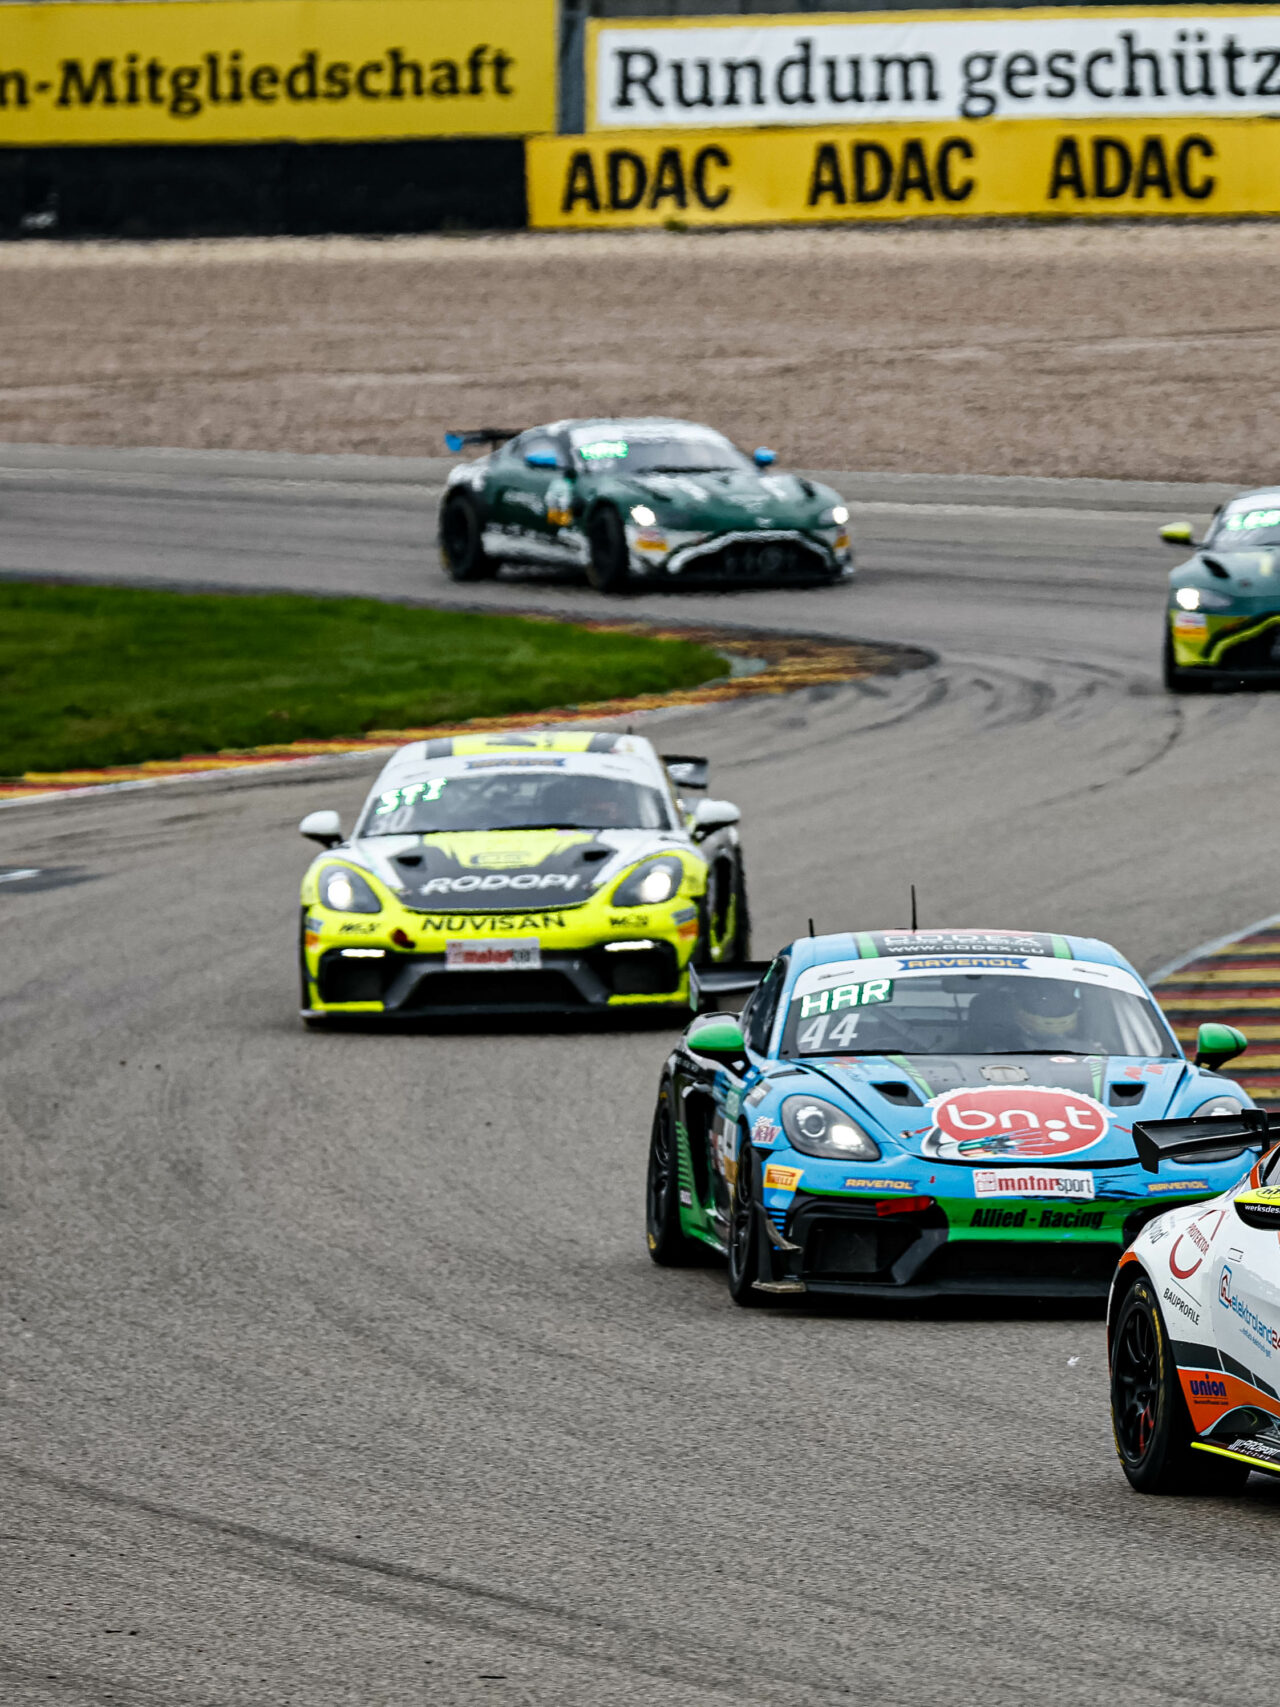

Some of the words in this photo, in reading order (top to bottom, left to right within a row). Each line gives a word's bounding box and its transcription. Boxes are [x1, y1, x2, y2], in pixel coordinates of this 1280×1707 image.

[612, 39, 940, 108] Rundum
[561, 145, 732, 213] ADAC
[808, 136, 976, 206] ADAC
[1048, 133, 1217, 200] ADAC
[419, 873, 581, 896] RODOPI
[420, 912, 567, 933] NUVISAN
[908, 957, 1020, 969] RAVENOL
[801, 978, 890, 1018] HAR
[799, 1012, 860, 1050] 44
[845, 1178, 913, 1190] RAVENOL
[997, 1174, 1093, 1194] motorsport
[968, 1208, 1028, 1228] Allied
[1038, 1209, 1106, 1229] Racing
[1186, 1222, 1210, 1257] PROTEKTOR
[1163, 1287, 1201, 1326] BAUPROFILE
[1190, 1373, 1227, 1397] union
